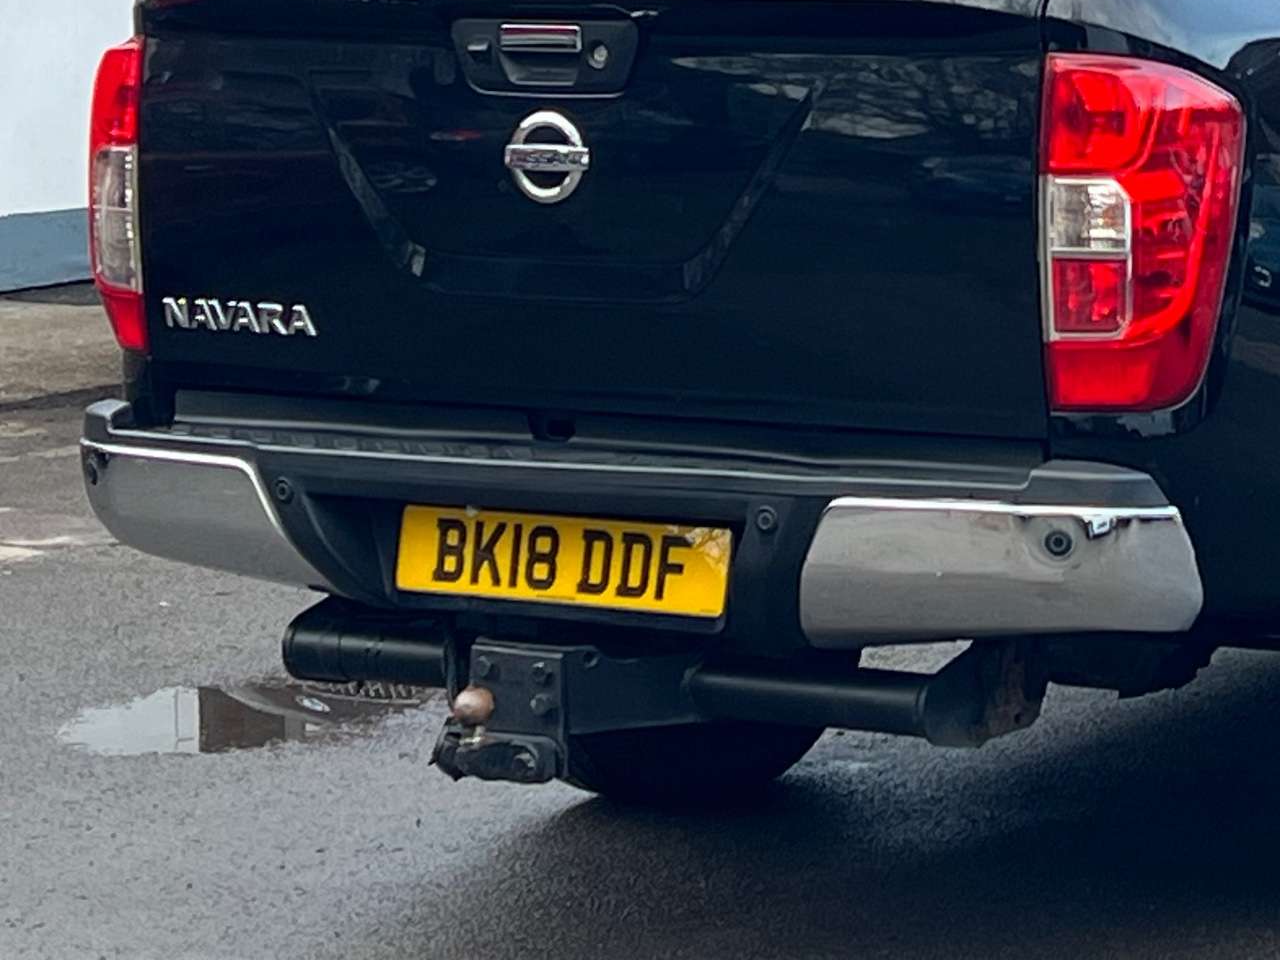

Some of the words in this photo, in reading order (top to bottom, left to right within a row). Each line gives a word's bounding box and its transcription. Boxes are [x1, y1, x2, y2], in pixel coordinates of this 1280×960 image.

[162, 297, 317, 336] NAVARA
[433, 518, 560, 590] BK18
[577, 530, 693, 601] DDF
